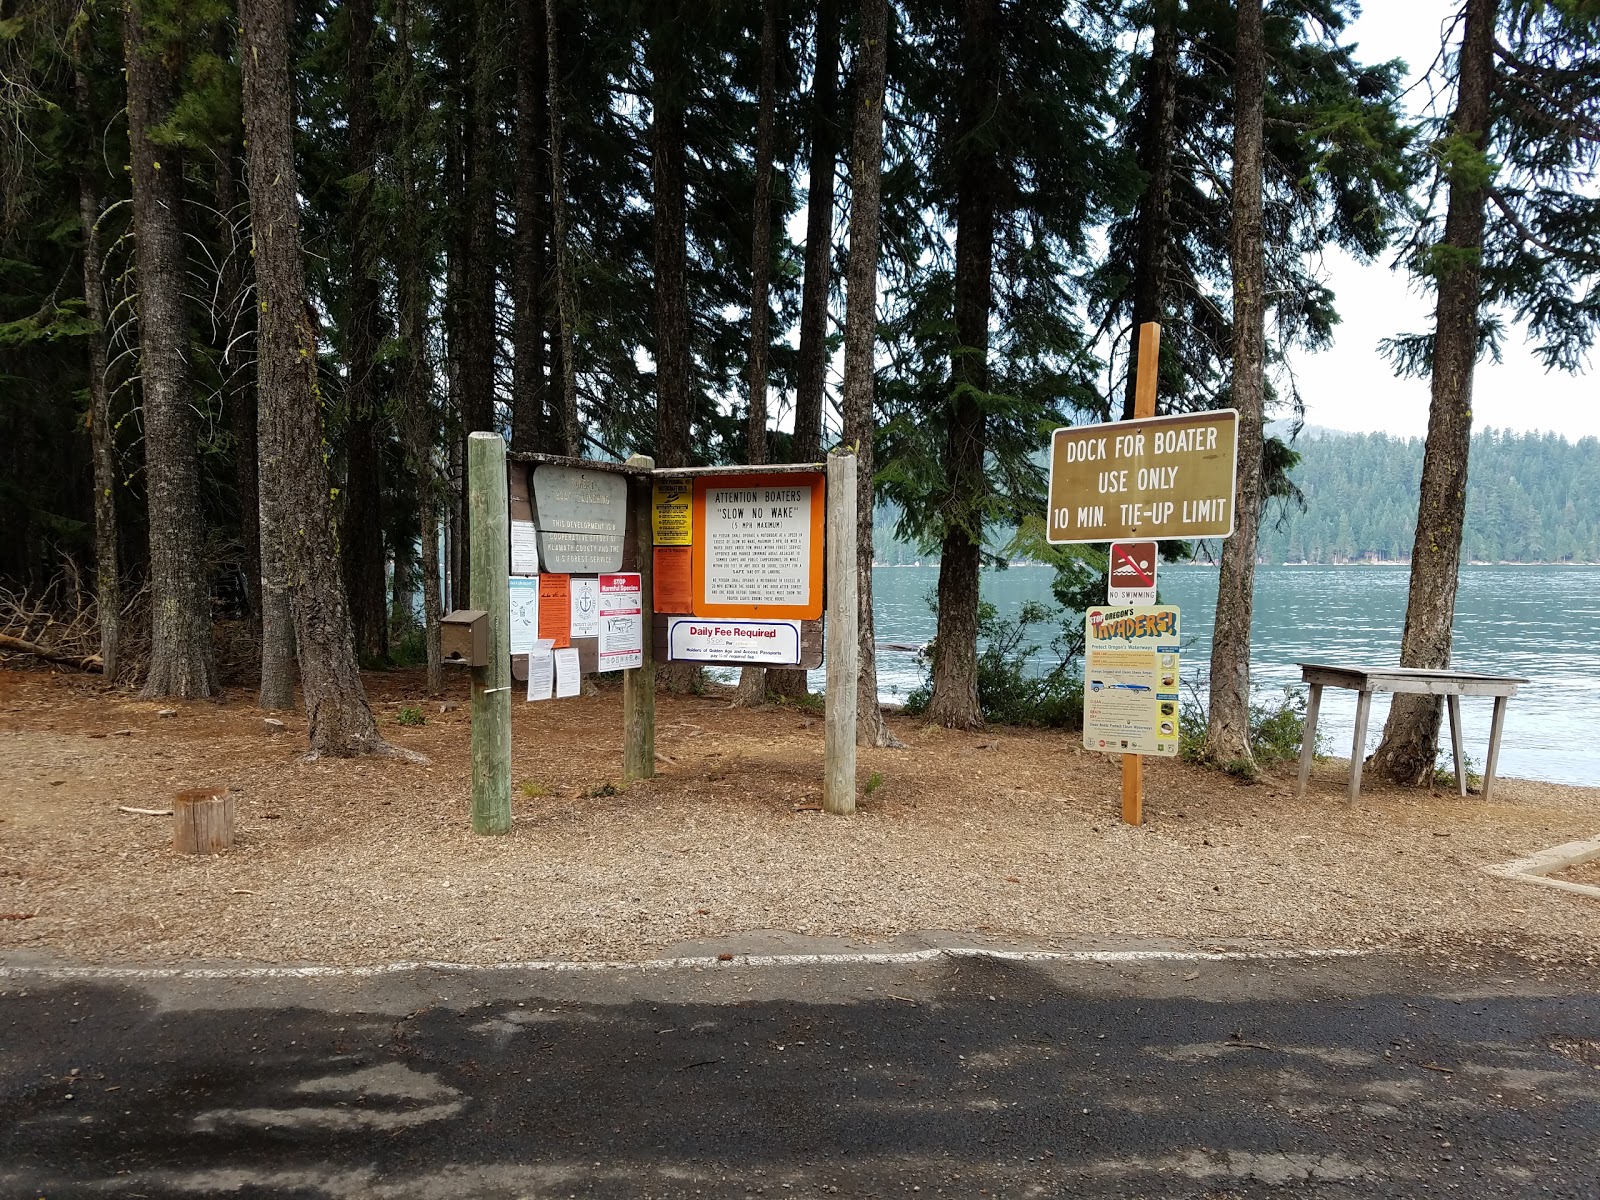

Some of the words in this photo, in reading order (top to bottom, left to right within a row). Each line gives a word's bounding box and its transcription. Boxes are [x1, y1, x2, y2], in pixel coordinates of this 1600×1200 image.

[1067, 438, 1107, 463] DOCK
[1115, 434, 1145, 458] FOR
[1154, 427, 1217, 454] BOATER
[1098, 470, 1128, 494] USE
[1137, 466, 1179, 491] ONLY
[715, 492, 758, 503] ATTENTION
[765, 490, 800, 502] BOATERS
[717, 508, 744, 519] "SLOW
[752, 508, 762, 518] NO
[771, 507, 798, 518] WAKE"
[1054, 508, 1068, 529] 10
[1078, 506, 1107, 528] MIN.
[1120, 502, 1174, 526] TIE-UP
[1182, 499, 1226, 523] LIMIT
[567, 521, 604, 530] DEVELOPMENT
[1089, 615, 1104, 624] STOP
[1105, 608, 1134, 620] OREGON'S
[690, 626, 713, 638] Daily
[715, 628, 732, 636] Fee
[734, 628, 776, 639] Required
